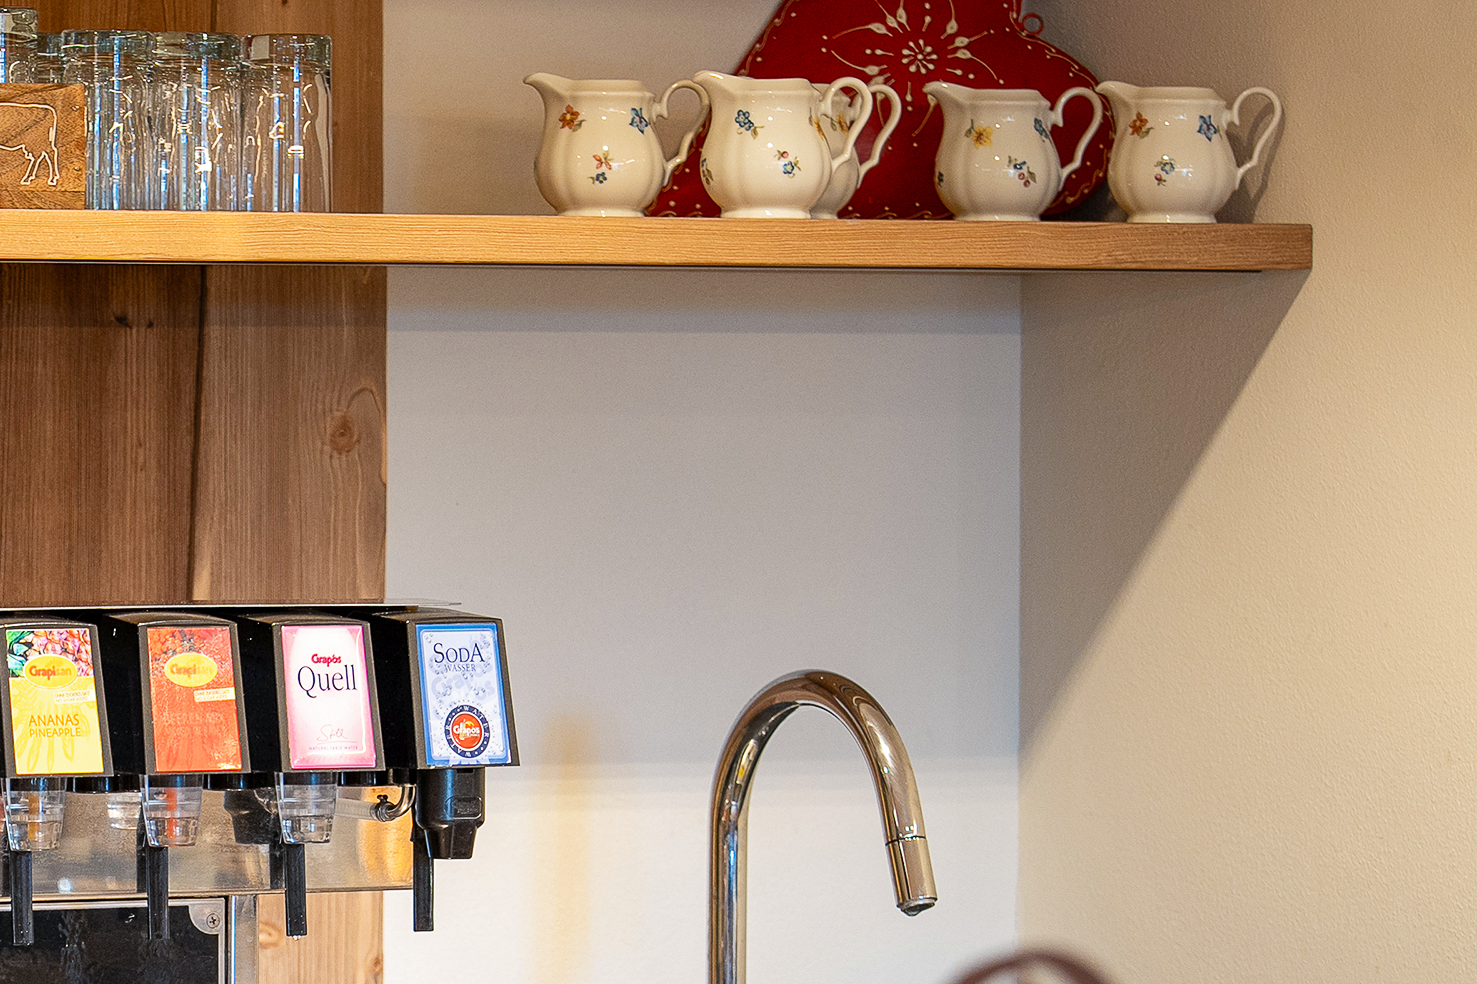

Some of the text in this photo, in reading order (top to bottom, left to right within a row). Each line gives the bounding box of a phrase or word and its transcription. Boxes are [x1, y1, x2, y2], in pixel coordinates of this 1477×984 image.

[433, 642, 485, 664] SODA
[444, 664, 477, 672] WASSER
[297, 664, 358, 698] Quell
[28, 713, 80, 727] ANANAS
[29, 727, 81, 738] PINEAPPLE
